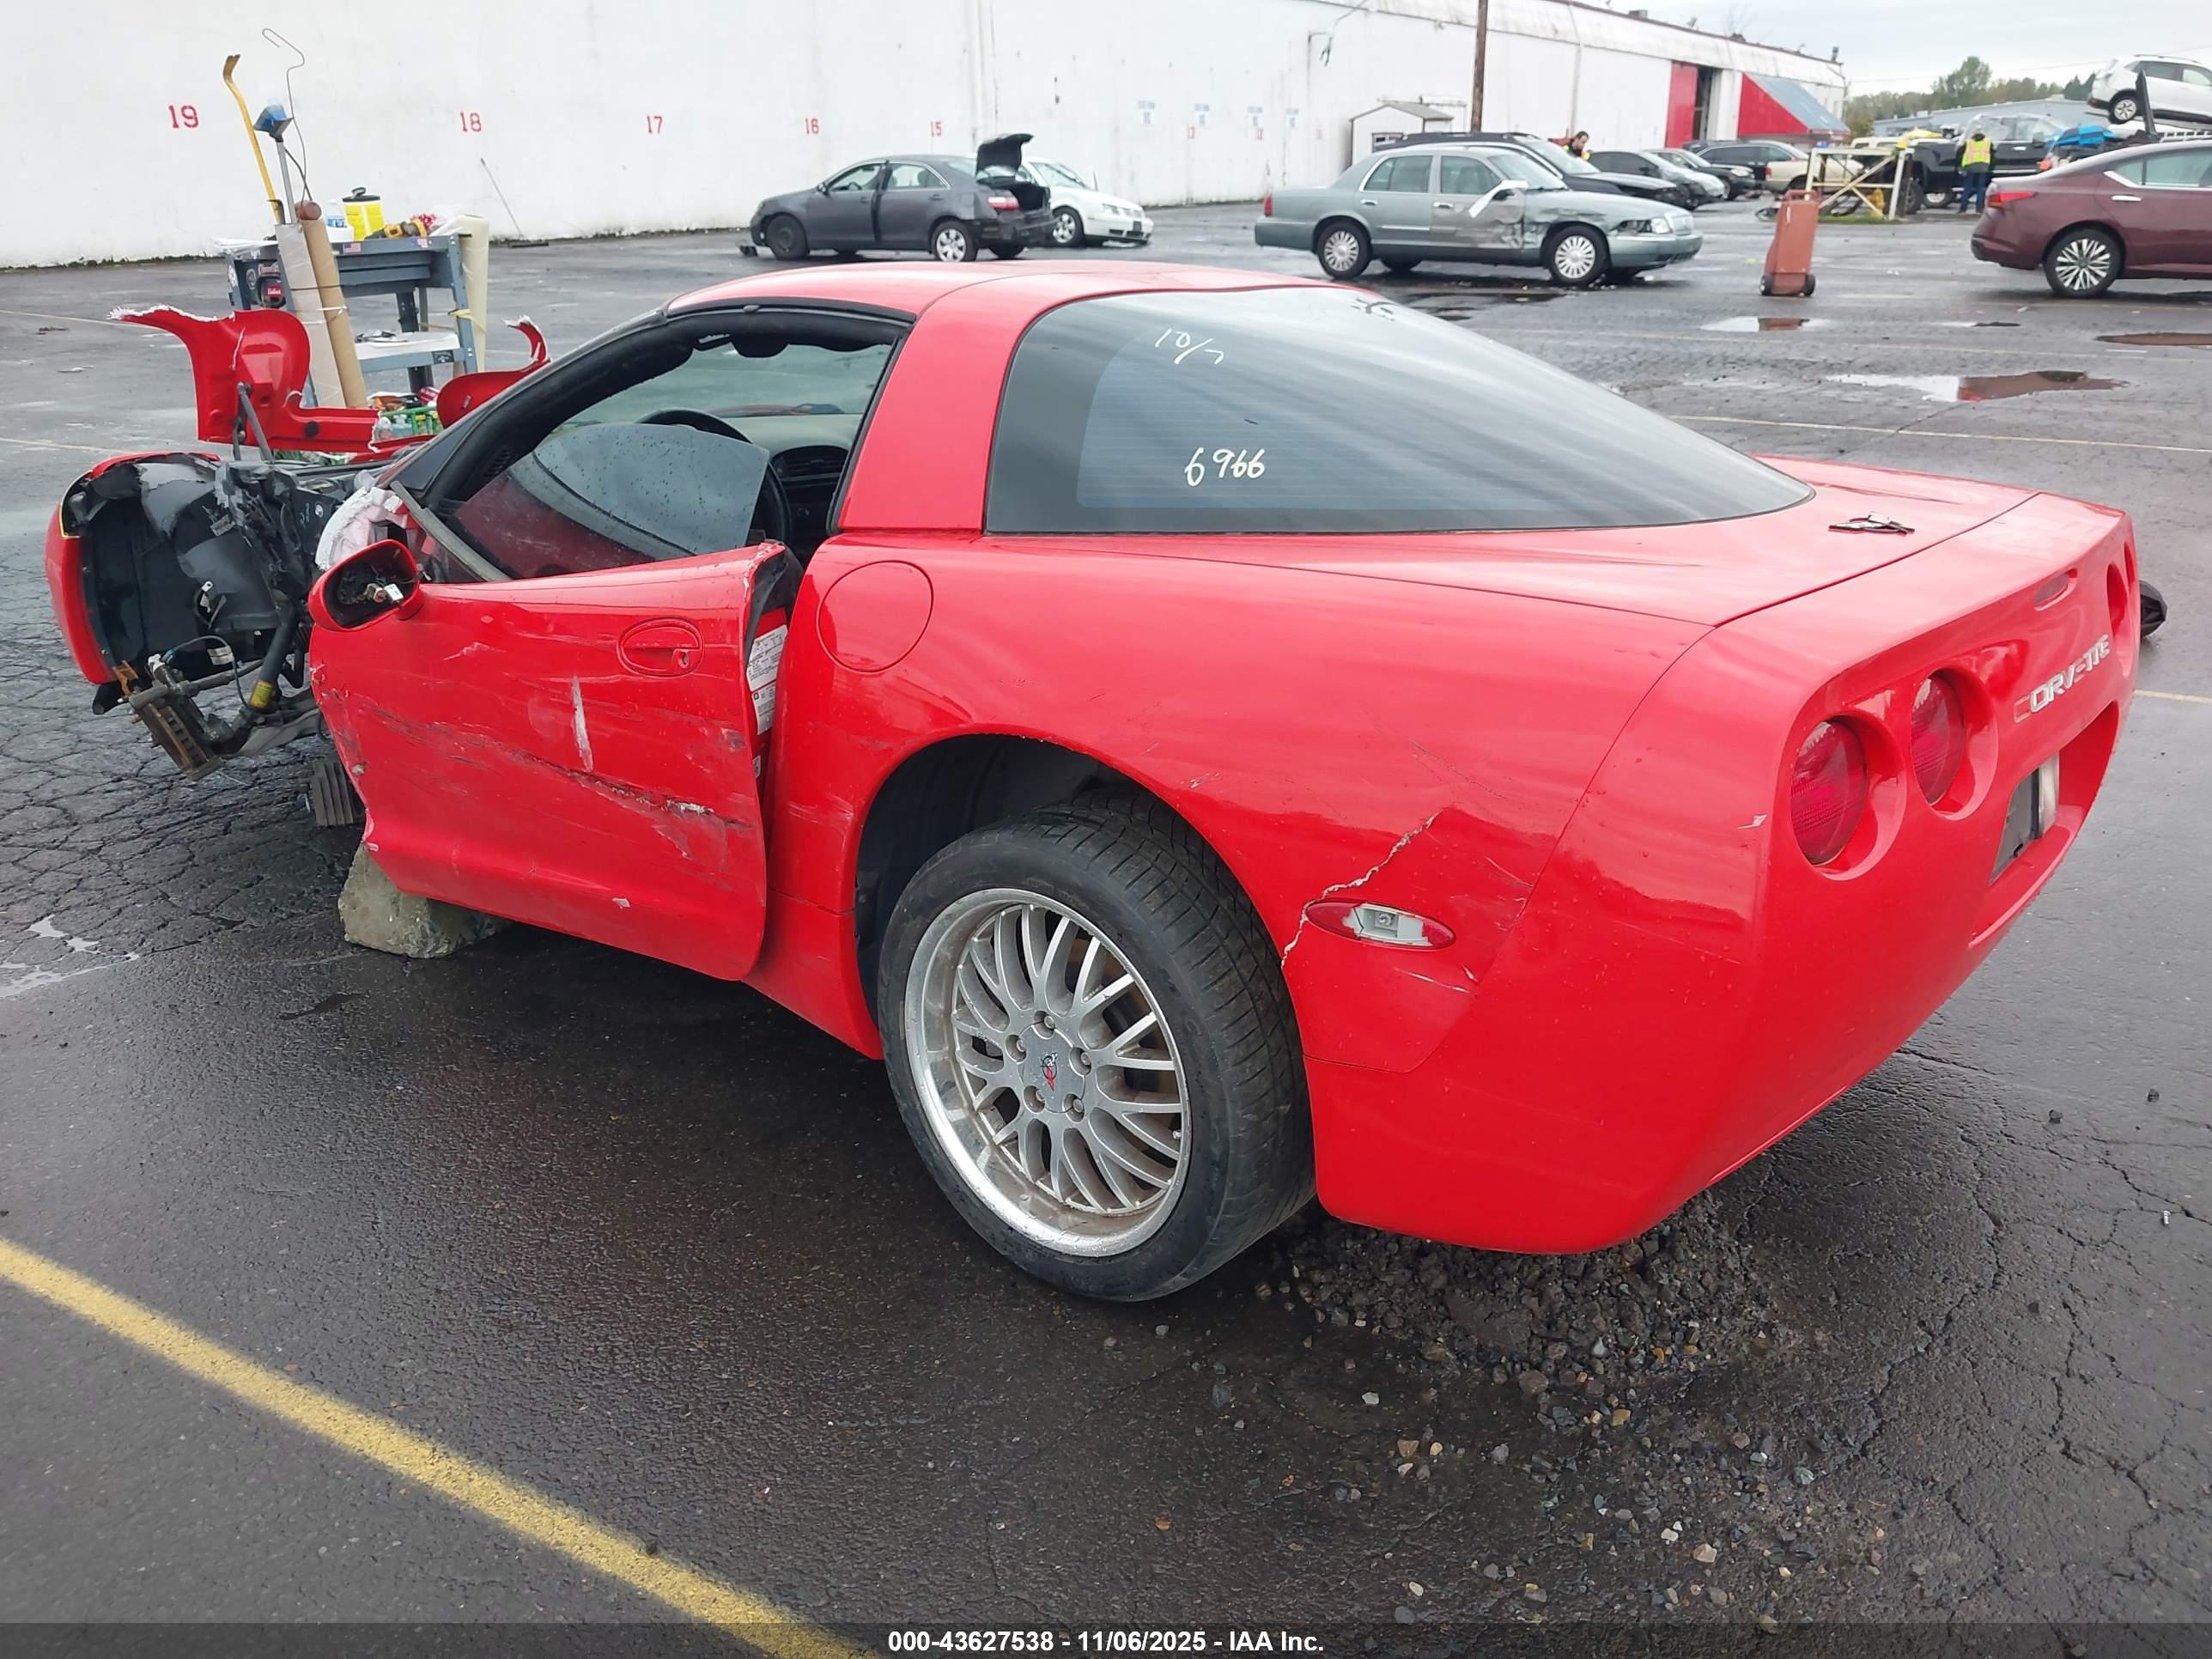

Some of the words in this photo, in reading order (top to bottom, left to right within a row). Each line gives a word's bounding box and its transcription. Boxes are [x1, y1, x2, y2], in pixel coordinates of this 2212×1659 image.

[168, 105, 199, 129] 19
[460, 112, 483, 133] 18
[646, 115, 664, 134] 17
[805, 118, 820, 135] 16
[930, 121, 943, 137] 15
[1154, 328, 1224, 365] 10/7
[1184, 447, 1265, 487] 6966
